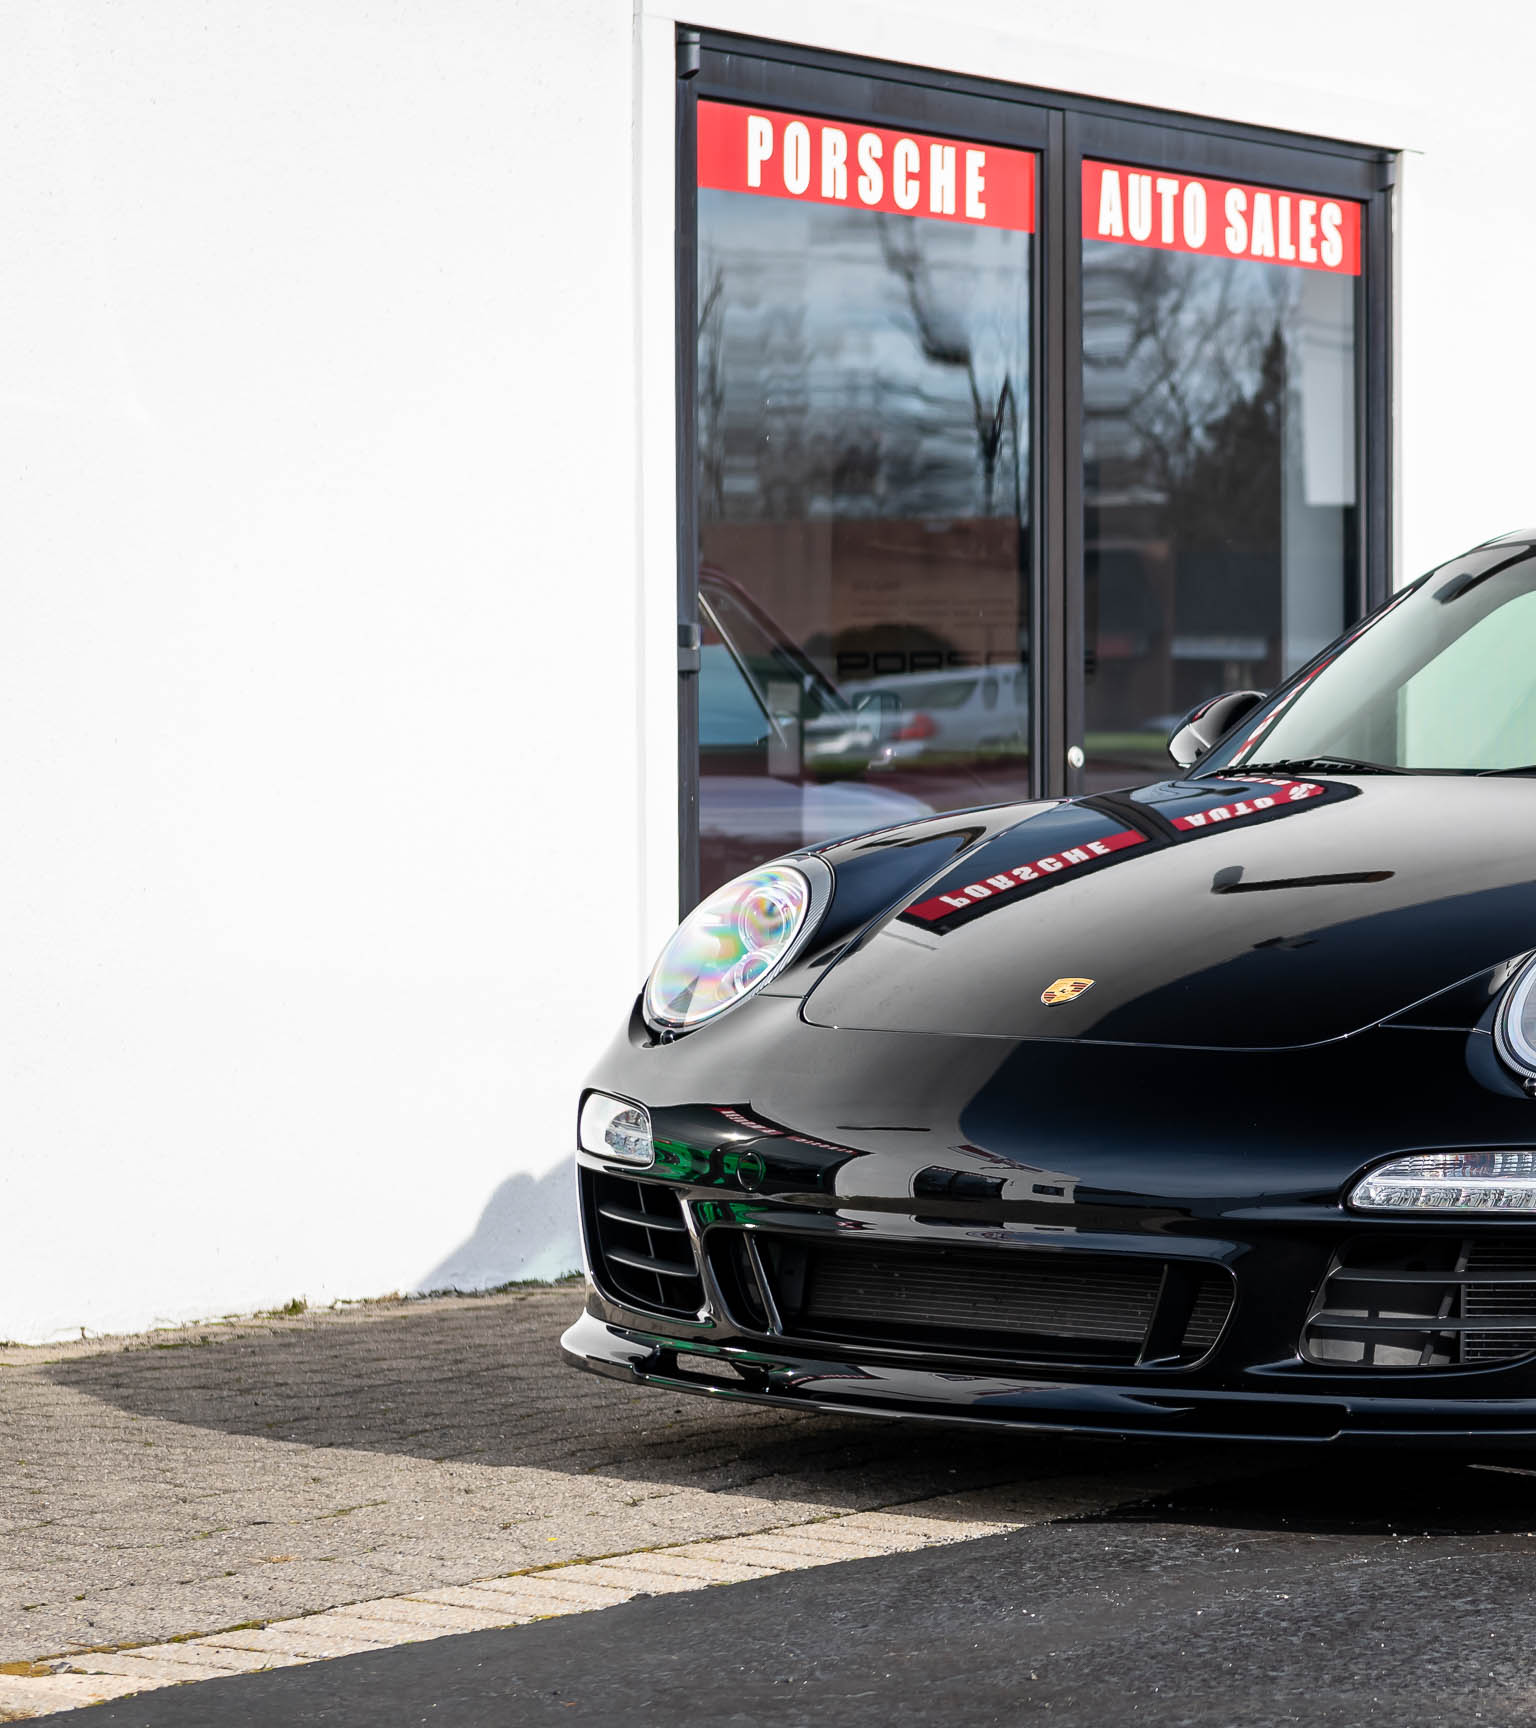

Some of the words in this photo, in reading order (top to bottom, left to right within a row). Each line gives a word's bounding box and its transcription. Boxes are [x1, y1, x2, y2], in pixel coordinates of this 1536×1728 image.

[747, 114, 986, 220] PORSCHE
[1098, 169, 1207, 248] AUTO
[1224, 188, 1343, 267] SALES
